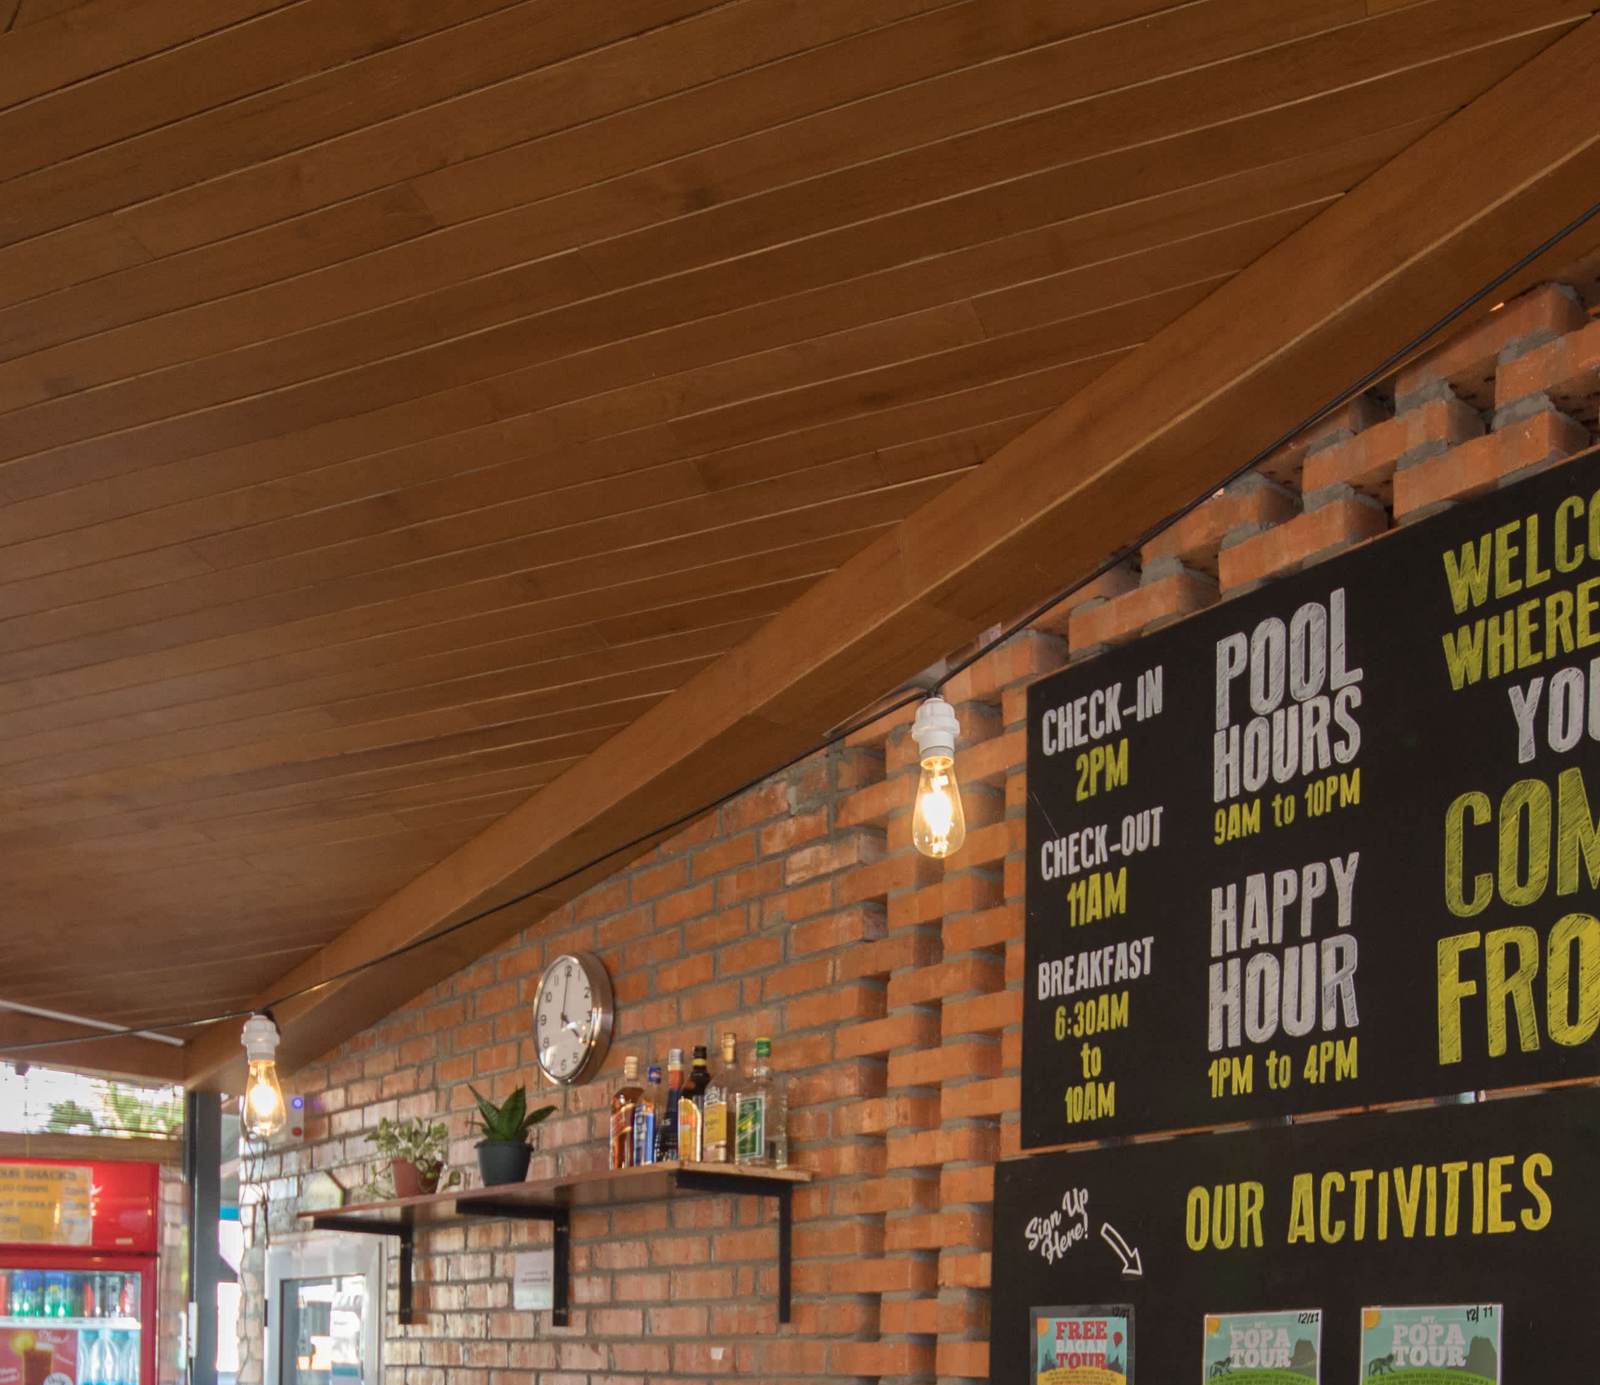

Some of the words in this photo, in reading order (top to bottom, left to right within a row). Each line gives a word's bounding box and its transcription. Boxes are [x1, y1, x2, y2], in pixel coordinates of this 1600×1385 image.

[1215, 587, 1363, 731] POOL
[1442, 576, 1600, 690] WHERE
[1042, 665, 1163, 756] CHECK-IN
[1076, 738, 1128, 803] 2PM
[1213, 685, 1363, 803] HOURS
[1214, 798, 1260, 845] 9AM
[1273, 793, 1295, 827] to
[1304, 768, 1360, 818] 10PM
[1041, 806, 1163, 883] CHECK-OUT
[1067, 867, 1127, 927] 11AM
[1210, 851, 1359, 957] HAPPY
[1038, 936, 1154, 1000] BREAKFAST
[1208, 934, 1359, 1052] HOUR
[1055, 990, 1128, 1041] 6:30AM
[1080, 1041, 1101, 1077] to
[1208, 1052, 1253, 1098] 1PM
[1267, 1048, 1291, 1089] to
[1303, 1036, 1358, 1084] 4PM
[1065, 1081, 1115, 1123] 10AM
[1025, 1210, 1062, 1251] Sign
[1062, 1187, 1089, 1217] Up
[1185, 1181, 1264, 1251] OUR
[1287, 1153, 1554, 1244] ACTIVITIES
[1056, 1321, 1108, 1341] FREE
[1056, 1339, 1107, 1354] BAGAN
[1056, 1352, 1106, 1370] TOUR
[1231, 1327, 1290, 1349] POPA
[1231, 1348, 1291, 1368] TOUR
[1392, 1323, 1466, 1346] POPA
[1392, 1345, 1467, 1367] TOUR
